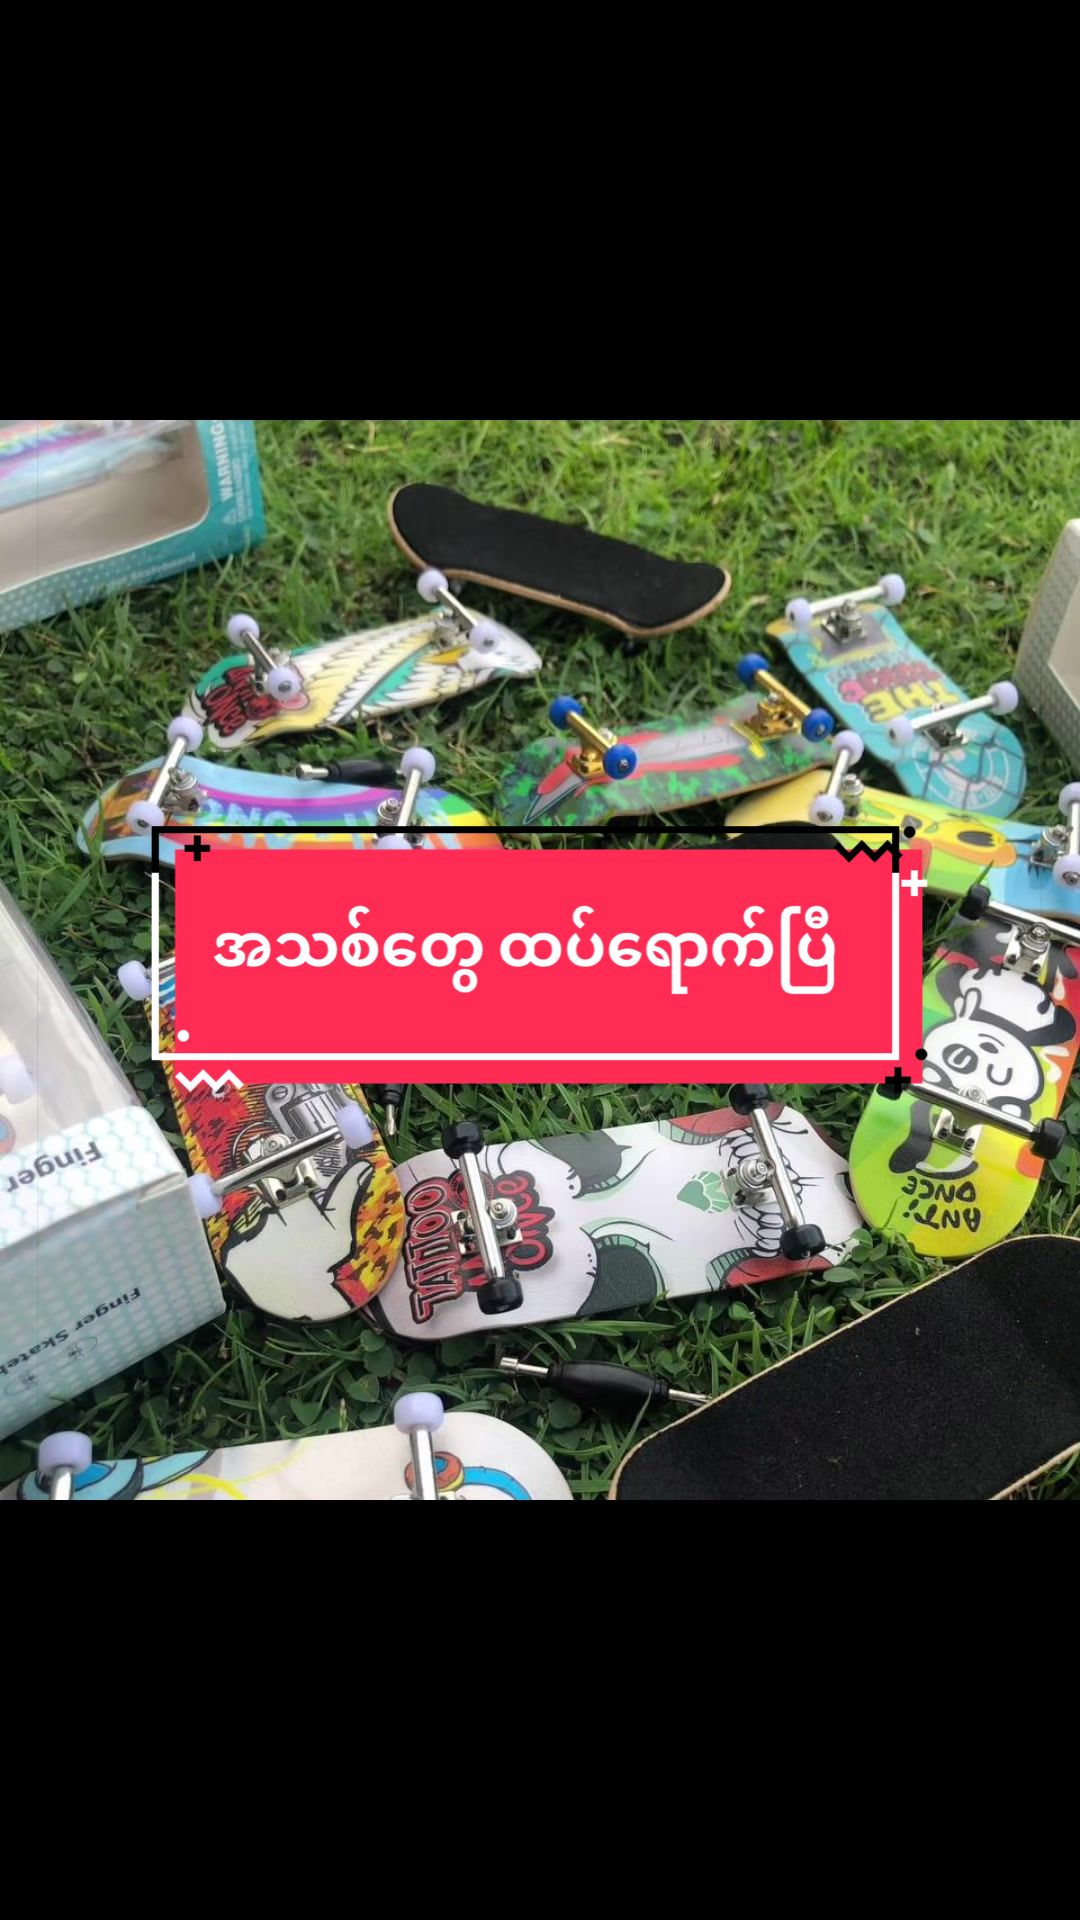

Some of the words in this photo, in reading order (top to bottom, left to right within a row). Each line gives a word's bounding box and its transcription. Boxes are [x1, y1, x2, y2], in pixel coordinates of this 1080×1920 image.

[7, 1141, 103, 1193] Finger
[901, 1175, 976, 1204] ONCE
[74, 1287, 141, 1330] Finger
